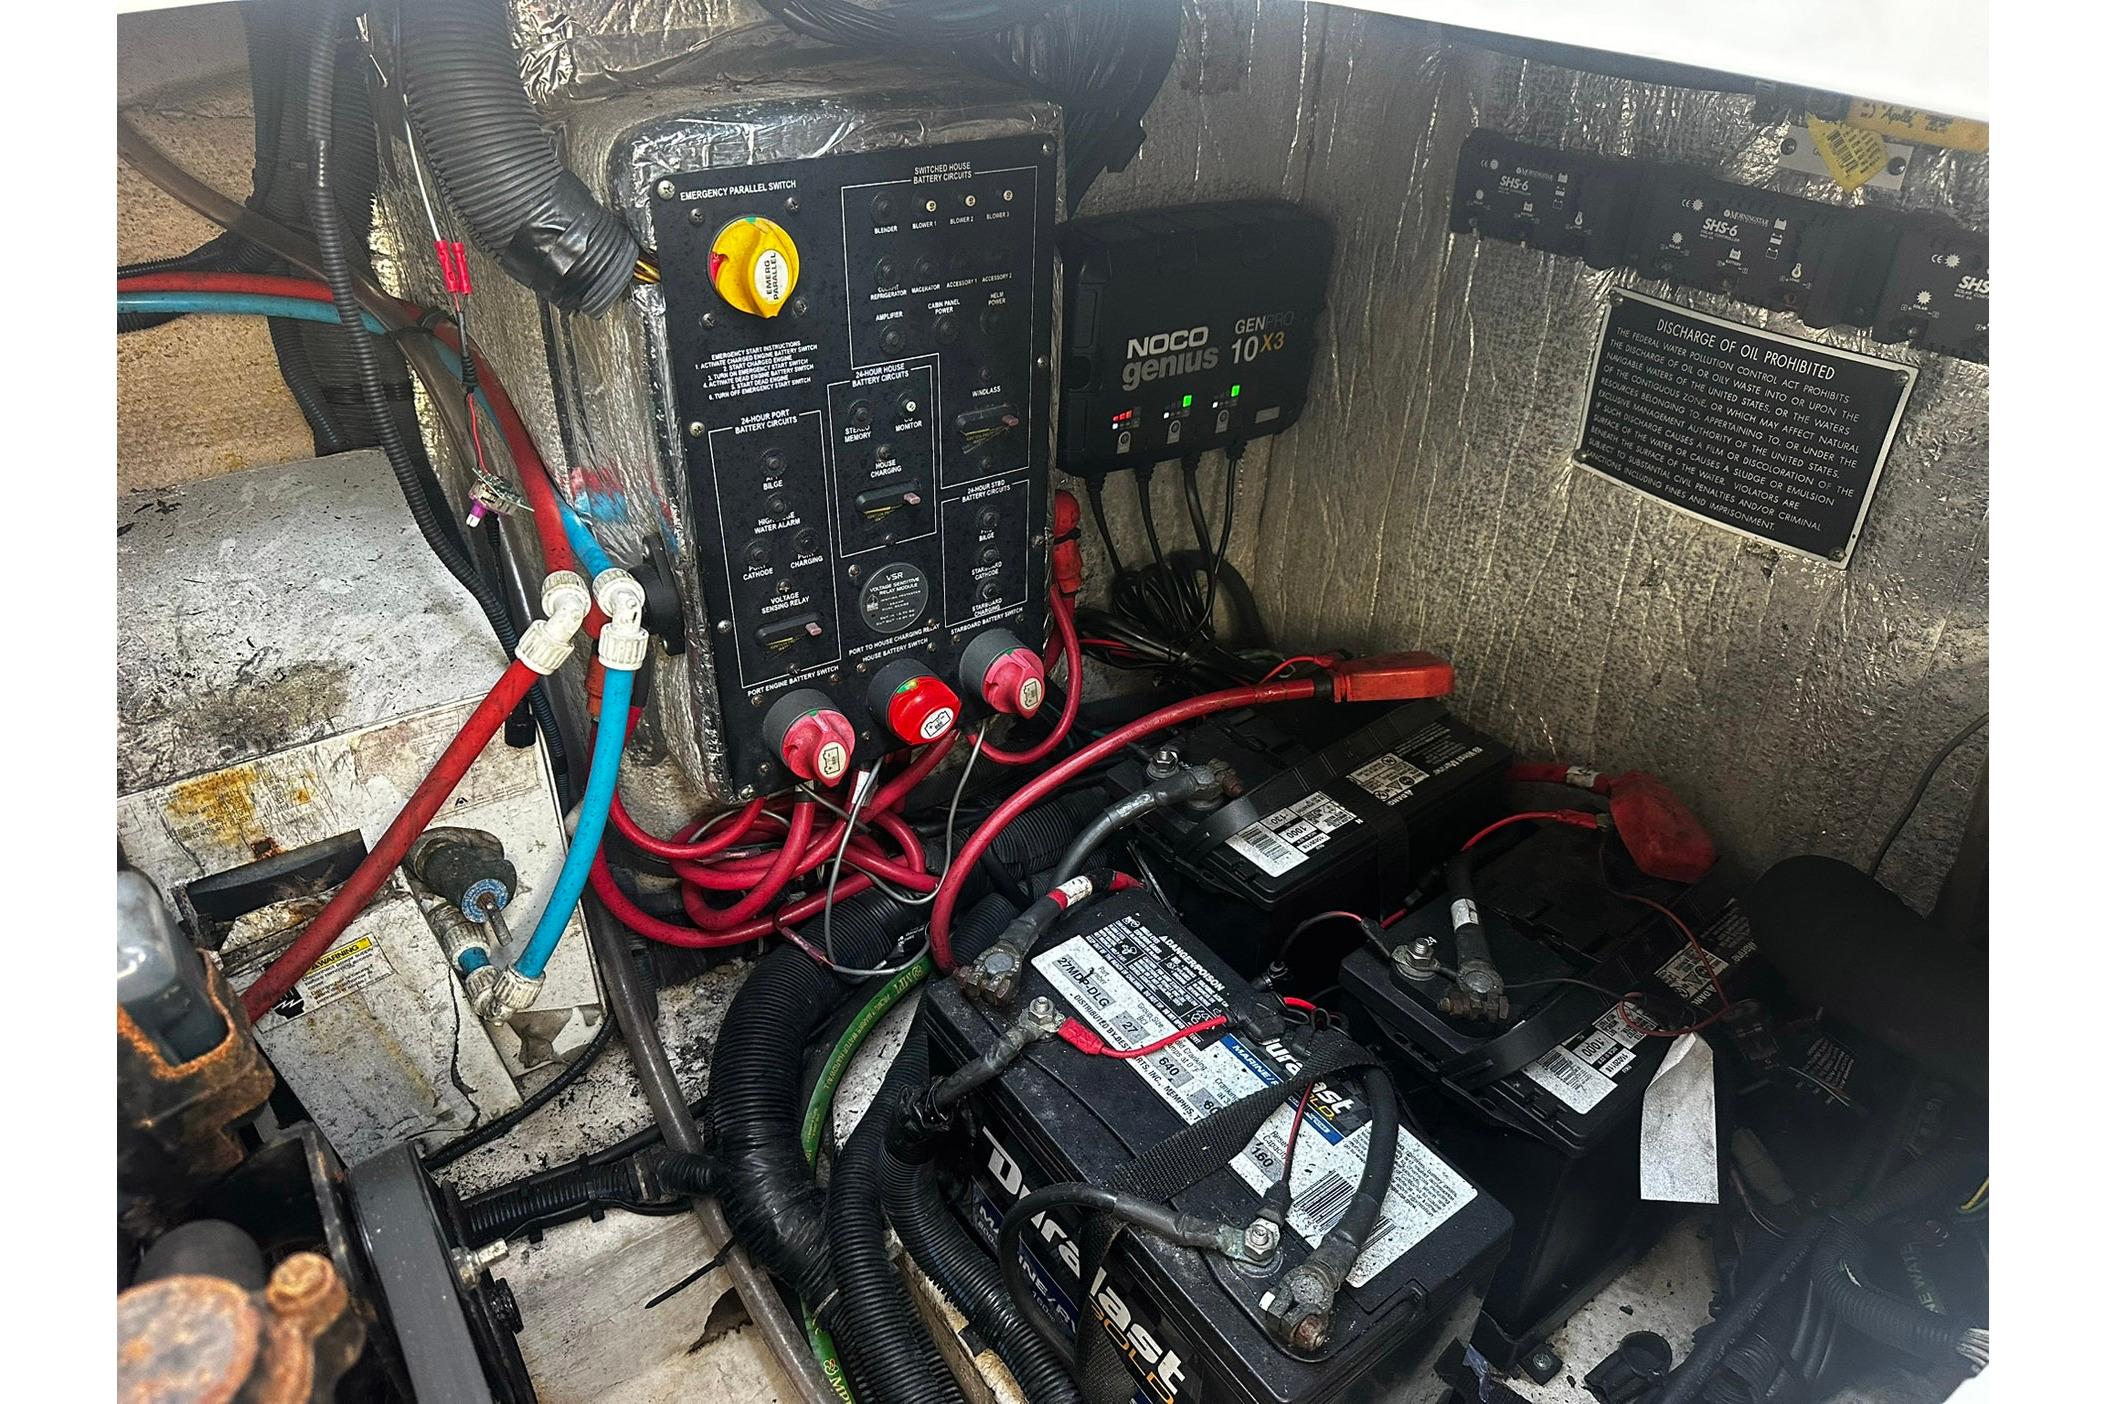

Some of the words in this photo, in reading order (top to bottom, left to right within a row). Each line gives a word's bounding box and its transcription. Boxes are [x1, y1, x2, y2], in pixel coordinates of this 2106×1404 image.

[914, 164, 948, 175] SWITCHED
[949, 162, 971, 171] HOUSE
[913, 173, 942, 185] BATTERY
[943, 170, 972, 181] CIRCUITS
[1499, 175, 1529, 191] SHS-6
[680, 187, 729, 201] EMERGENCY
[729, 183, 767, 196] PARALLEL
[768, 180, 796, 191] SWITCH
[874, 225, 898, 235] BLENDER
[1703, 217, 1738, 237] SHS-6
[764, 260, 772, 295] EMERG
[770, 252, 779, 300] PARALLEL
[870, 289, 907, 301] REFRIGERATOR
[911, 284, 941, 294] MACERATOR
[927, 301, 943, 310] CABIN
[944, 299, 960, 307] PANEL
[988, 298, 1006, 306] POWER
[875, 311, 904, 322] AMPLIFIER
[935, 306, 954, 315] POWER
[1234, 311, 1295, 335] GENPRO
[711, 349, 745, 361] EMERGENCY
[745, 346, 763, 355] START
[763, 340, 801, 352] INSTRUCTIONS
[1126, 326, 1209, 360] NOCO
[1656, 318, 1717, 348] DISCHARGE
[1719, 338, 1736, 353] OF
[1740, 344, 1759, 361] OIL
[1763, 350, 1835, 381] PROHIBITED
[855, 366, 882, 379] 24-HOUR
[883, 363, 905, 374] HOUSE
[1122, 347, 1220, 392] genius
[1616, 326, 1631, 338] THE
[1632, 331, 1659, 348] FEDERAL
[1663, 342, 1687, 357] WATER
[1689, 351, 1734, 372] POLLUTION
[1736, 366, 1778, 385] CONTROL
[1781, 379, 1799, 390] ACT
[1802, 384, 1850, 404] PROHIBITS
[852, 375, 880, 388] BATTERY
[881, 371, 909, 382] CIRCUITS
[1609, 339, 1623, 350] THE
[1625, 344, 1665, 364] DISCHARGE
[1667, 359, 1679, 368] OF
[1681, 363, 1694, 375] OIL
[1696, 368, 1709, 379] OR
[1711, 373, 1731, 385] OILY
[1733, 380, 1761, 395] WASTE
[1764, 389, 1787, 402] INTO
[1791, 397, 1805, 407] OR
[1808, 401, 1837, 416] UPON
[1841, 410, 1860, 423] THE
[971, 385, 1001, 397] WINDLASS
[1606, 352, 1643, 371] NAVIGABLE
[1646, 367, 1673, 382] WATERS
[1676, 376, 1688, 385] OF
[1690, 381, 1705, 393] THE
[1707, 387, 1738, 403] UNITED
[1774, 407, 1789, 418] OR
[1793, 412, 1811, 424] THE
[1814, 418, 1850, 436] WATERS
[740, 412, 770, 425] 24-HOUR
[771, 408, 790, 418] PORT
[1603, 364, 1614, 374] OF
[1616, 369, 1629, 380] THE
[1630, 375, 1680, 399] CONTIGUOUS
[1710, 402, 1723, 413] OR
[1726, 407, 1757, 423] WHICH
[1759, 418, 1779, 430] MAY
[1782, 425, 1815, 441] AFFECT
[1818, 435, 1860, 454] NATURAL
[734, 422, 766, 435] BATTERY
[766, 416, 798, 428] CIRCUITS
[895, 420, 922, 432] MONITOR
[1600, 377, 1638, 398] RESOURCES
[1641, 392, 1685, 414] BELONGING
[1703, 415, 1763, 440] APPERTAINING
[1785, 440, 1800, 451] OR
[1802, 445, 1835, 462] UNDER
[1839, 456, 1858, 469] THE
[844, 431, 871, 443] MEMORY
[870, 465, 902, 479] CHARGING
[875, 459, 896, 470] HOUSE
[763, 480, 783, 491] BILGE
[967, 483, 990, 494] 24-HOUR
[962, 491, 986, 503] BATTERY
[986, 485, 1011, 497] CIRCUITS
[754, 522, 777, 534] WATER
[777, 518, 801, 530] ALARM
[790, 555, 824, 569] CHARGING
[743, 567, 774, 581] CATHODE
[886, 571, 903, 580] VSR
[869, 582, 892, 593] VOLTAGE
[893, 577, 920, 588] SENSITIVE
[879, 587, 895, 595] RELAY
[896, 582, 918, 592] MODULE
[761, 601, 789, 614] SENSING
[790, 595, 810, 608] RELAY
[770, 592, 800, 605] VOLTAGE
[951, 620, 981, 635] STARBOARD
[982, 612, 1004, 626] BATTERY
[1004, 607, 1023, 619] SWITCH
[849, 646, 863, 656] PORT
[864, 644, 874, 652] TO
[875, 637, 893, 648] HOUSE
[894, 628, 922, 642] CHARGING
[923, 622, 940, 634] RELAY
[862, 651, 880, 662] HOUSE
[881, 643, 906, 656] BATTERY
[907, 637, 928, 649] SWITCH
[748, 686, 764, 696] PORT
[765, 679, 788, 692] ENGINE
[789, 672, 815, 686] BATTERY
[816, 665, 839, 679] SWITCH
[1285, 824, 1308, 839] 1000
[319, 944, 360, 968] WARNING
[1056, 956, 1111, 1008] 27MDP-DLG
[1122, 1020, 1138, 1034] 27
[1158, 1056, 1180, 1077] 640
